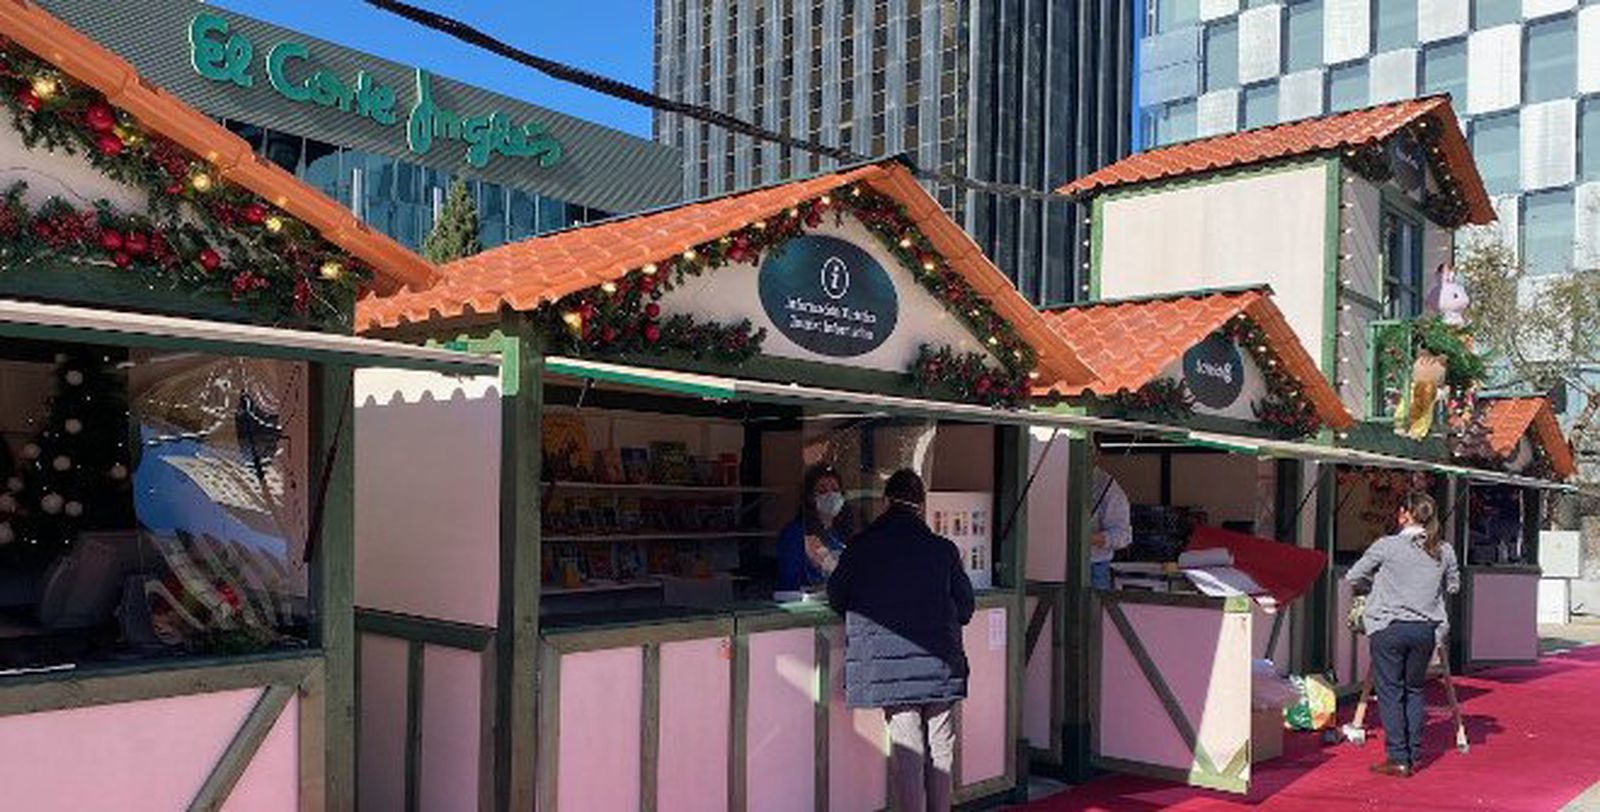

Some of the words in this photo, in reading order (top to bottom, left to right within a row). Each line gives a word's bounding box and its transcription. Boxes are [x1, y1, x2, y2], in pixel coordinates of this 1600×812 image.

[188, 11, 252, 88] El
[266, 42, 397, 126] Corte
[407, 66, 562, 169] Inglés
